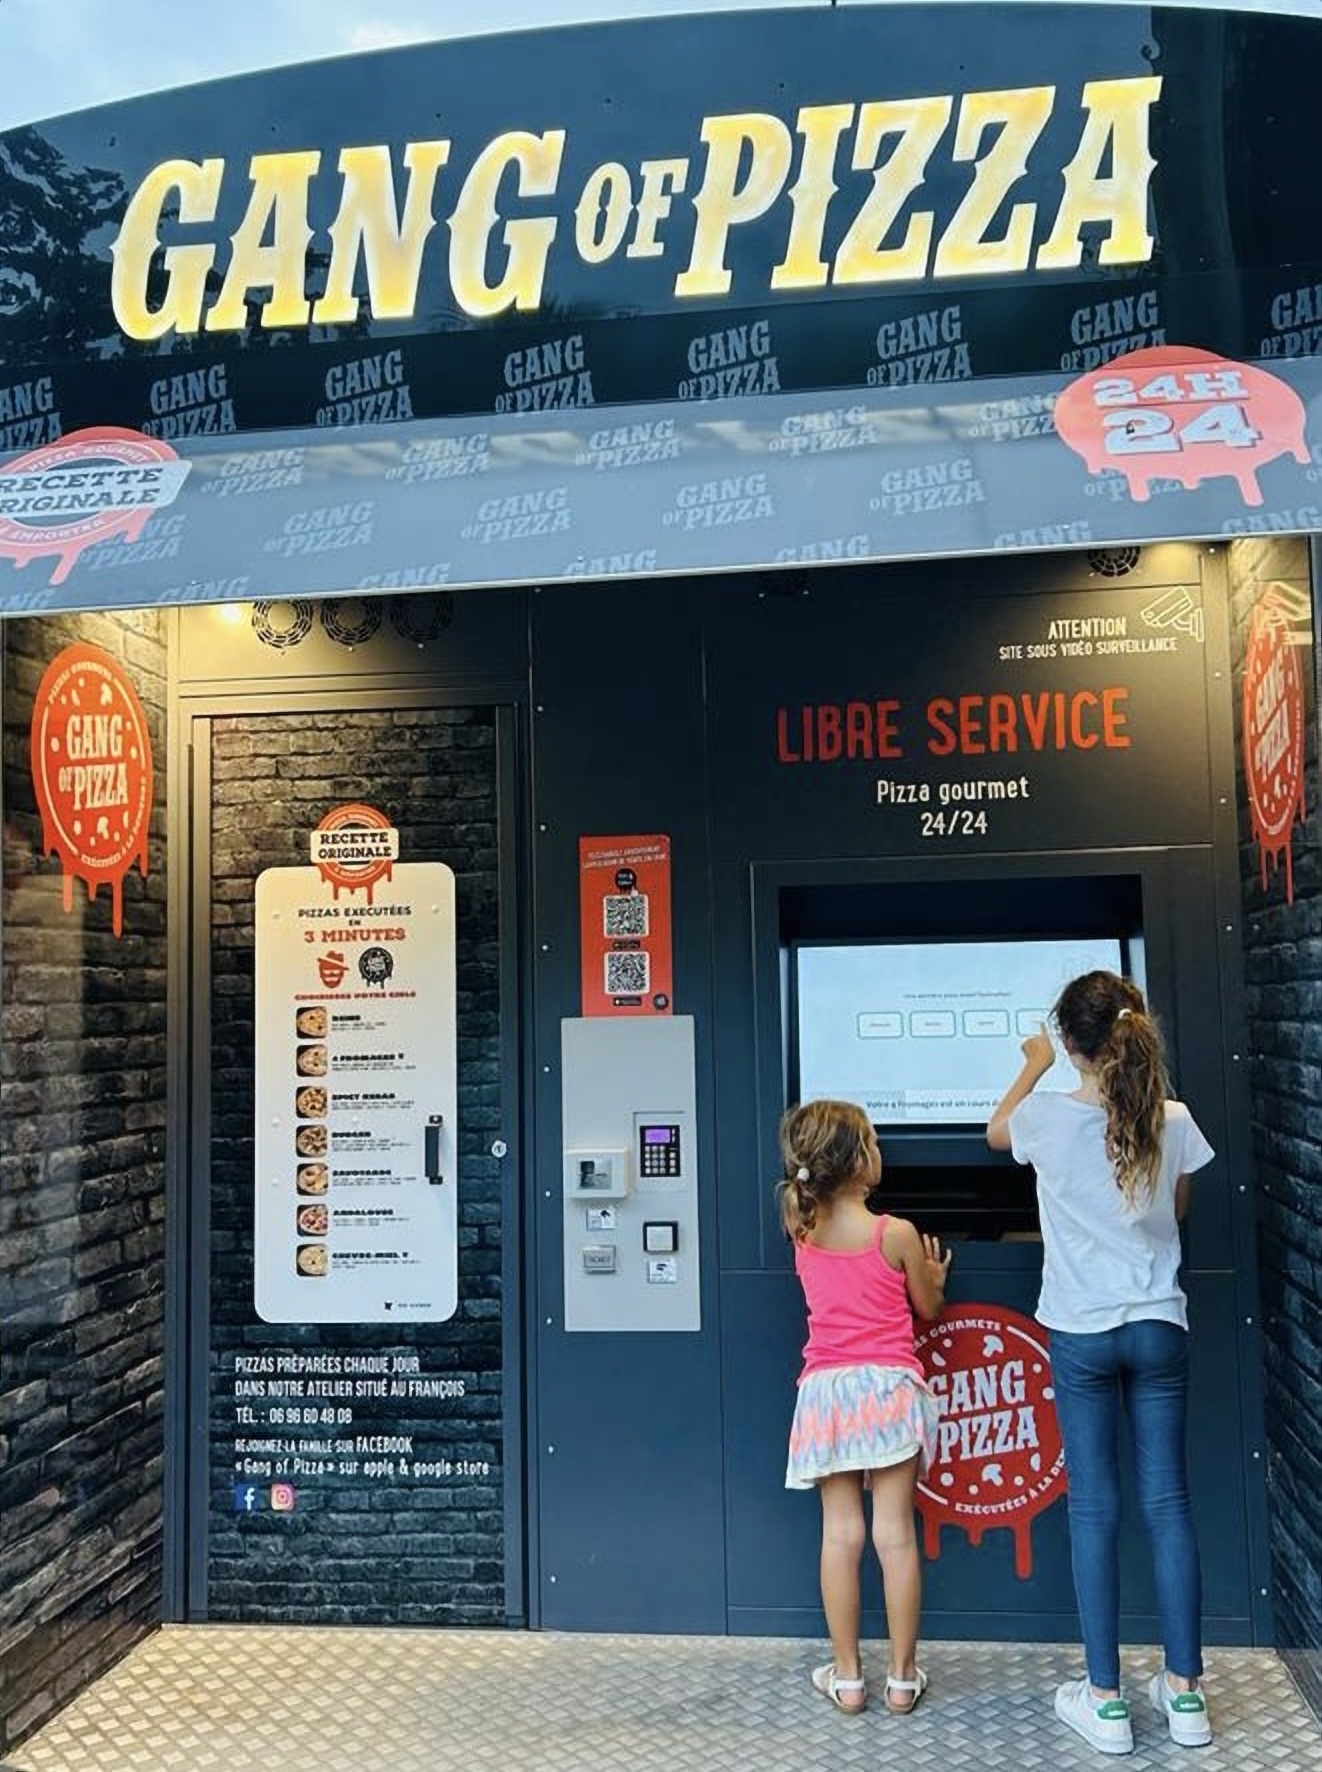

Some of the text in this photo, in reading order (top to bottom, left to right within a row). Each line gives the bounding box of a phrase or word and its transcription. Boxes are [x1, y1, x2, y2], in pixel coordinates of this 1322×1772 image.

[109, 76, 1163, 341] GANG OF PIZZA
[876, 305, 961, 359] GANG
[1071, 290, 1159, 345] GANG
[504, 335, 584, 387] GANG
[688, 320, 770, 373] GANG
[325, 349, 403, 401] GANG
[699, 357, 781, 401] PIZZA
[889, 342, 972, 387] PIZZA
[150, 363, 227, 415] GANG
[515, 371, 595, 415] PIZZA
[1093, 371, 1249, 407] 24H
[336, 385, 414, 429] PIZZA
[781, 406, 866, 437] GANG
[589, 419, 675, 450] GANG
[790, 425, 878, 456] PIZZA
[1102, 403, 1262, 455] 24
[221, 447, 305, 478] GANG
[402, 433, 488, 464] GANG
[592, 438, 679, 470] PIZZA
[0, 468, 163, 492] RECETTE
[218, 465, 304, 498] PIZZA
[403, 452, 490, 484] PIZZA
[880, 460, 974, 494] GANG
[0, 488, 161, 514] RIGINALE
[479, 487, 568, 521] GANG
[675, 473, 768, 507] GANG
[890, 481, 986, 516] PIZZA
[284, 501, 374, 534] GANG
[480, 507, 573, 544] PIZZA
[683, 494, 776, 530] PIZZA
[1223, 507, 1321, 534] GANG
[284, 520, 374, 557] PIZZA
[776, 535, 869, 562] GANG
[993, 521, 1090, 548] GANG
[1048, 617, 1126, 640] ATTENTION
[1000, 637, 1179, 660] SITE SOUS VIDÉO SURVEILLANCE
[67, 715, 122, 760] GANG
[777, 687, 1130, 763] LIBRE SERVICE
[73, 763, 128, 810] PIZZA
[877, 776, 1029, 805] Pizza gourmet
[320, 832, 388, 844] RECETTE
[920, 810, 988, 836] 24/24
[318, 847, 391, 859] ORIGINALE
[298, 907, 339, 918] PIZZAS
[304, 928, 406, 943] 3 MINUTES
[929, 1318, 1001, 1338] GOURMETS
[235, 1354, 420, 1374] PIZZAS PRÉPARÉES CHAQUE JOUR
[235, 1377, 465, 1399] DANS NOTRE ATELIER SITUÉ AU FRANÇOIS
[927, 1360, 1026, 1417] GANG
[269, 1407, 284, 1424] 06
[286, 1407, 301, 1424] 96
[320, 1407, 335, 1424] 48
[356, 1436, 413, 1453] FACEBOOK
[938, 1405, 1039, 1464] PIZZA
[276, 1458, 289, 1474] of
[340, 1462, 359, 1475] sur
[364, 1458, 394, 1478] apple
[400, 1458, 409, 1475] &
[413, 1458, 451, 1478] google
[456, 1460, 490, 1475] store
